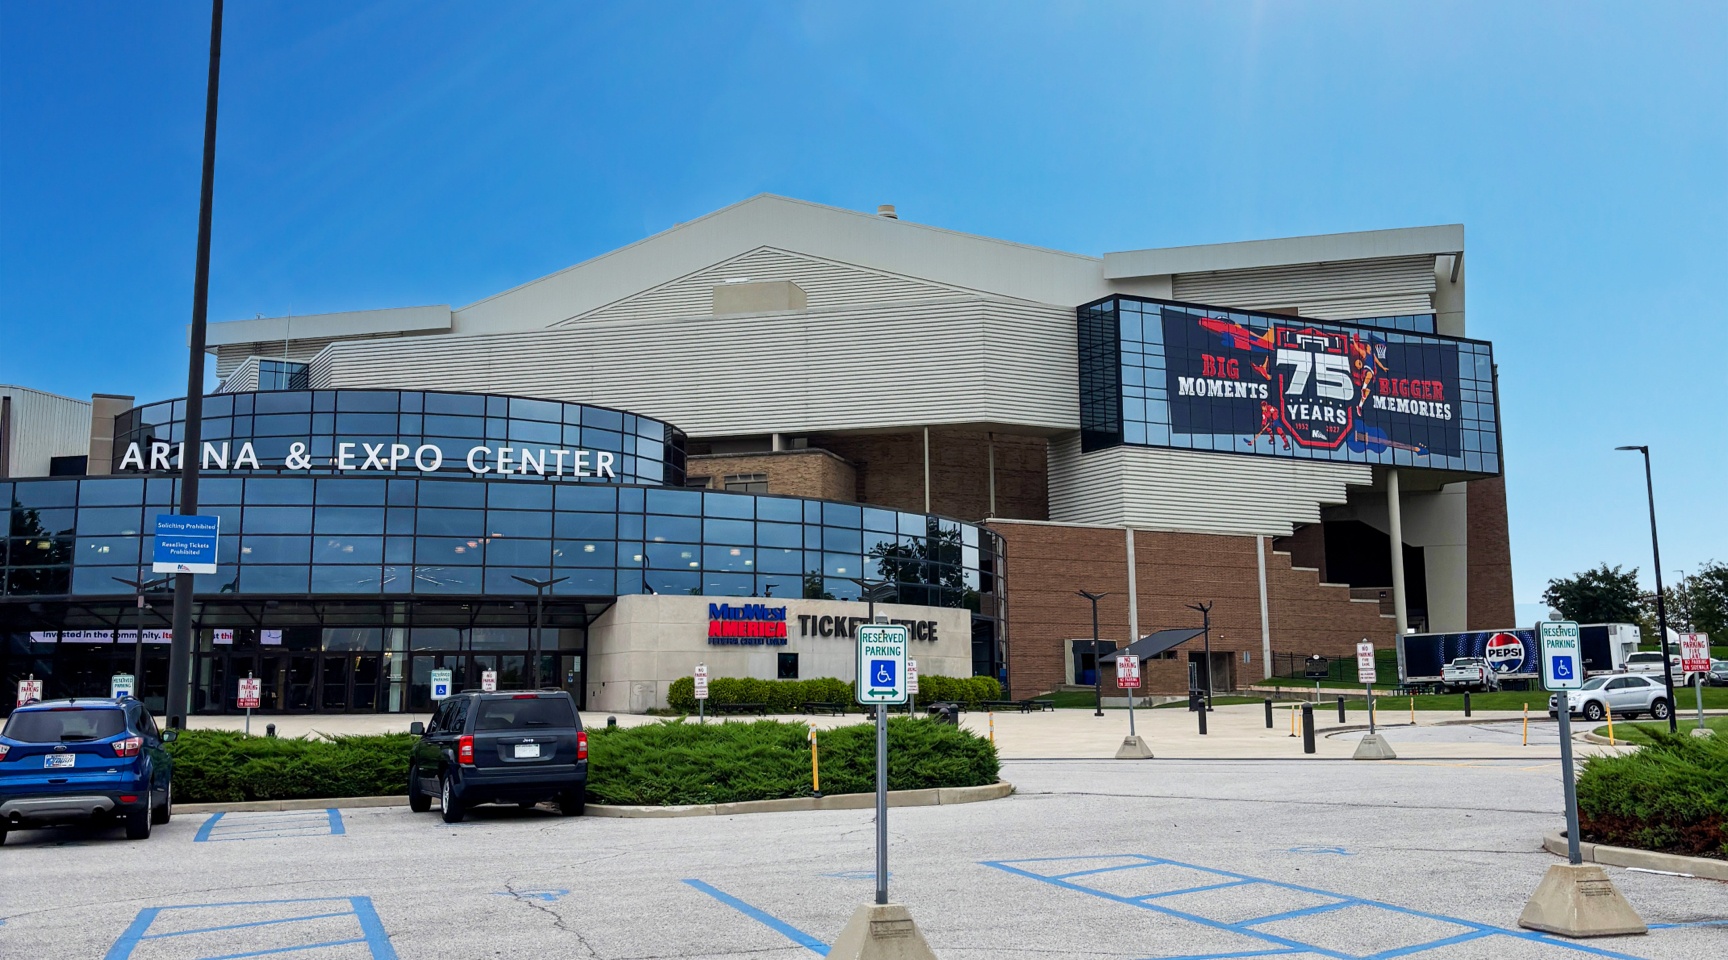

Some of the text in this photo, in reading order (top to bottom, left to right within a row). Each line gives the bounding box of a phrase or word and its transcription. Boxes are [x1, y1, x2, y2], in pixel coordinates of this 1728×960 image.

[1201, 353, 1240, 380] BIG
[1276, 348, 1354, 401] 75
[1178, 376, 1269, 399] MOMENTS
[1379, 377, 1445, 401] BIGGER
[1287, 404, 1347, 425] YEARS
[1372, 395, 1452, 421] MEMORIES
[284, 441, 312, 470] &
[338, 442, 443, 472] EXPO
[466, 446, 616, 478] CENTER
[157, 522, 185, 530] Soliciting
[161, 541, 188, 549] Reselling
[83, 630, 91, 638] in
[93, 630, 108, 638] the
[708, 620, 787, 637] AMERICA
[1543, 628, 1577, 637] RESERVED
[862, 633, 904, 643] RESERVED
[1547, 640, 1576, 648] PARKING
[865, 646, 901, 656] PARKING
[1488, 648, 1522, 658] PEPSI
